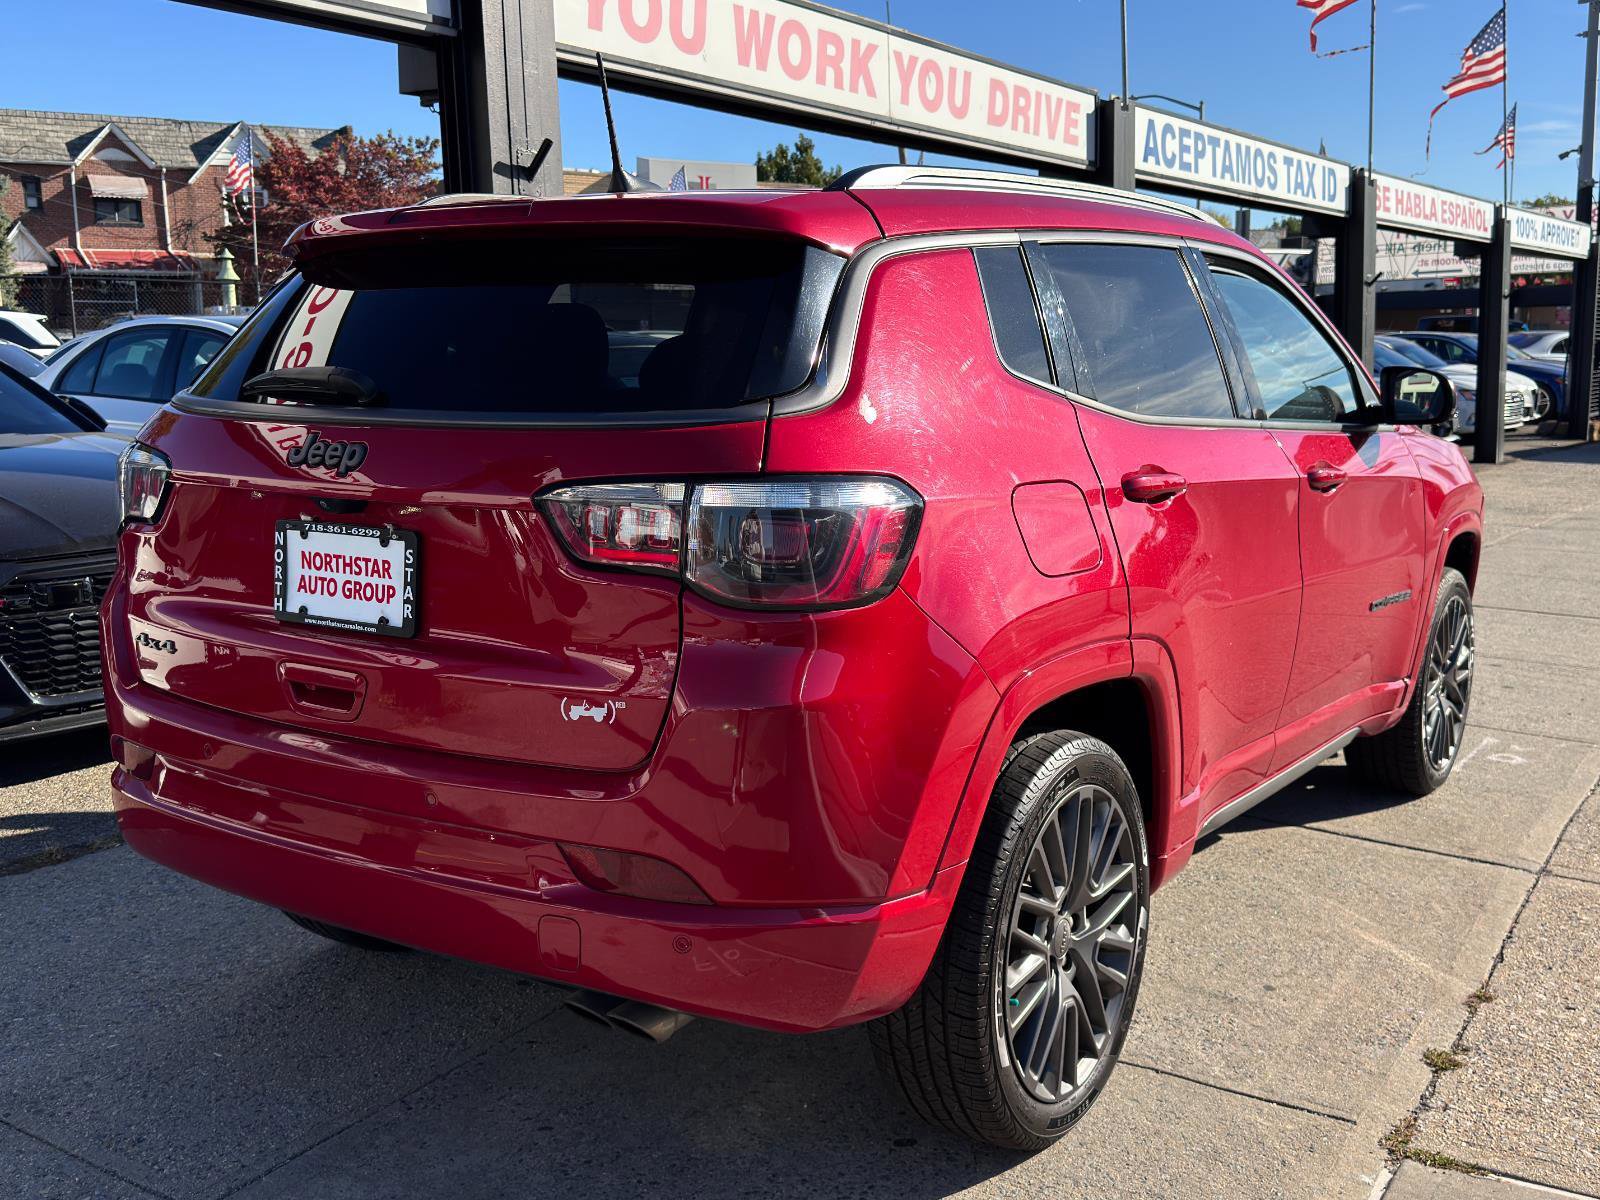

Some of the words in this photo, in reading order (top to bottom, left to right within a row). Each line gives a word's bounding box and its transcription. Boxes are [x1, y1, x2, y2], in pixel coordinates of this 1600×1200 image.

[733, 4, 880, 99] WORK
[893, 49, 972, 120] YOU
[986, 77, 1081, 146] DRIVE
[1142, 118, 1278, 190] ACEPTAMOS
[1283, 156, 1316, 200] TAX
[1321, 165, 1337, 203] ID
[1395, 189, 1438, 222] HABLA
[1440, 199, 1489, 233] ESPAÑOL
[1516, 216, 1538, 240] 100%
[286, 430, 369, 477] Jeep
[304, 523, 381, 538] 718-361-6299
[273, 531, 284, 612] NORTH
[301, 550, 393, 579] NORTHSTAR
[297, 574, 338, 597] AUTO
[341, 579, 397, 605] GROUP
[403, 549, 414, 619] STAR
[136, 632, 178, 655] 4x4
[304, 617, 377, 633] www.northstarcarsales.com
